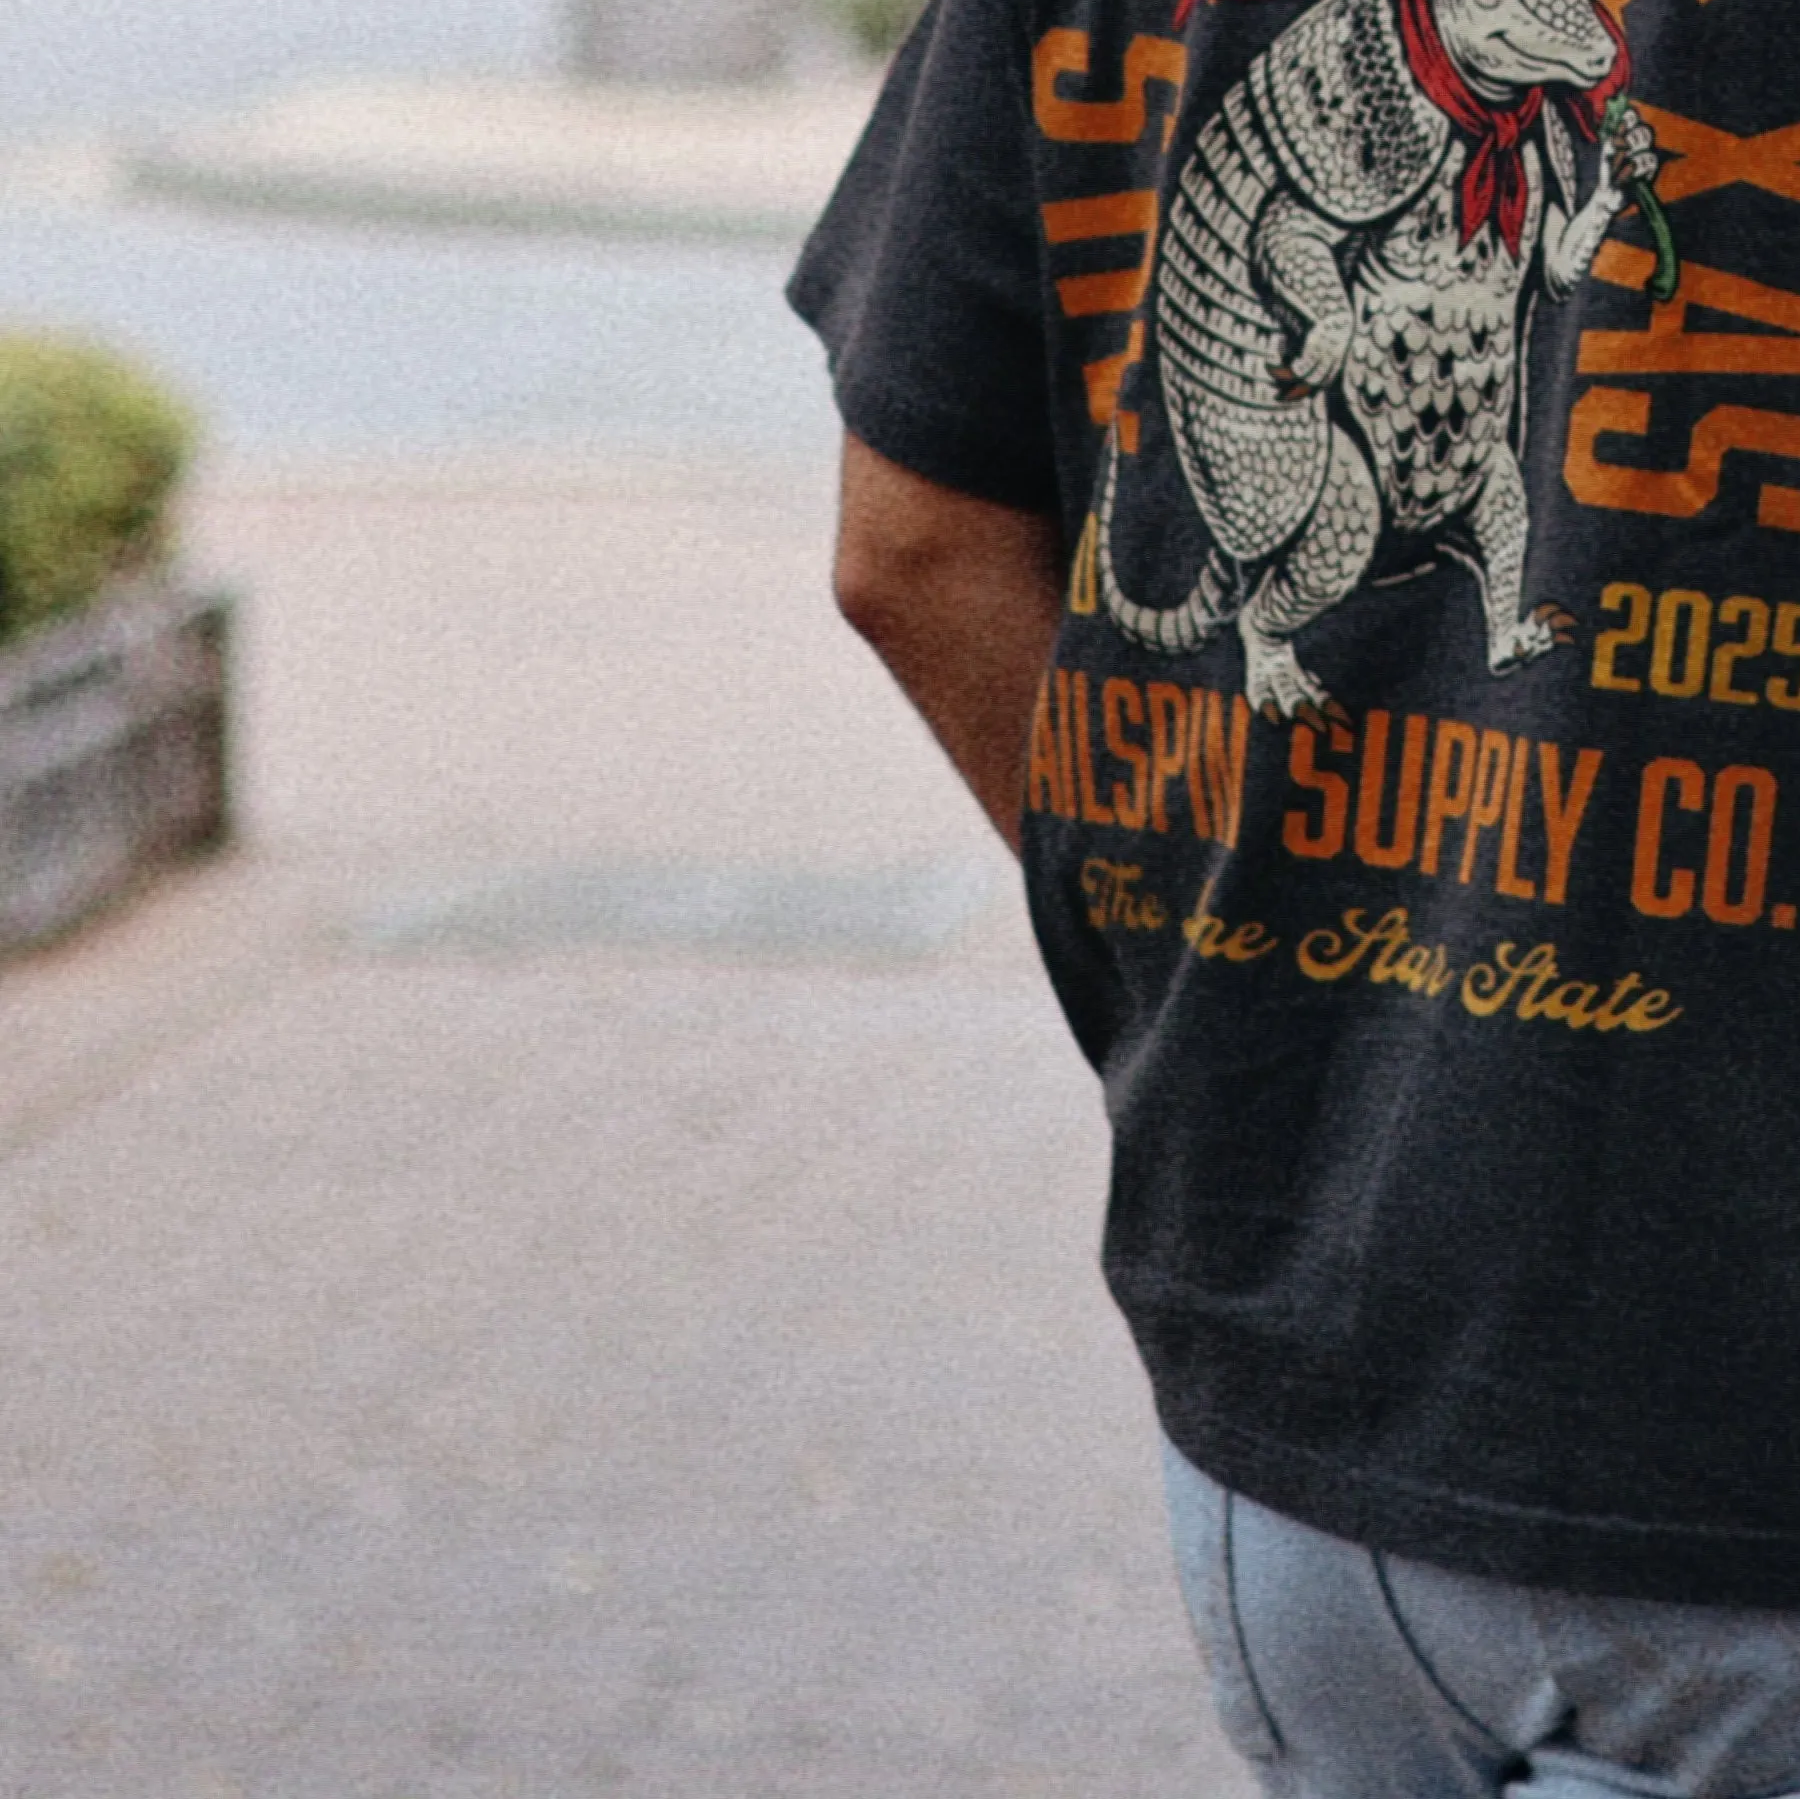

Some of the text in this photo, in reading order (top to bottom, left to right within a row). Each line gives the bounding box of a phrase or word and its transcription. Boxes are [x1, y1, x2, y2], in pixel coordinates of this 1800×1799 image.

[1282, 709, 1604, 904] SUPPLY
[1630, 756, 1797, 929] CO.
[1081, 857, 1168, 929] The
[1297, 907, 1454, 997] Star
[1462, 942, 1684, 1031] State
